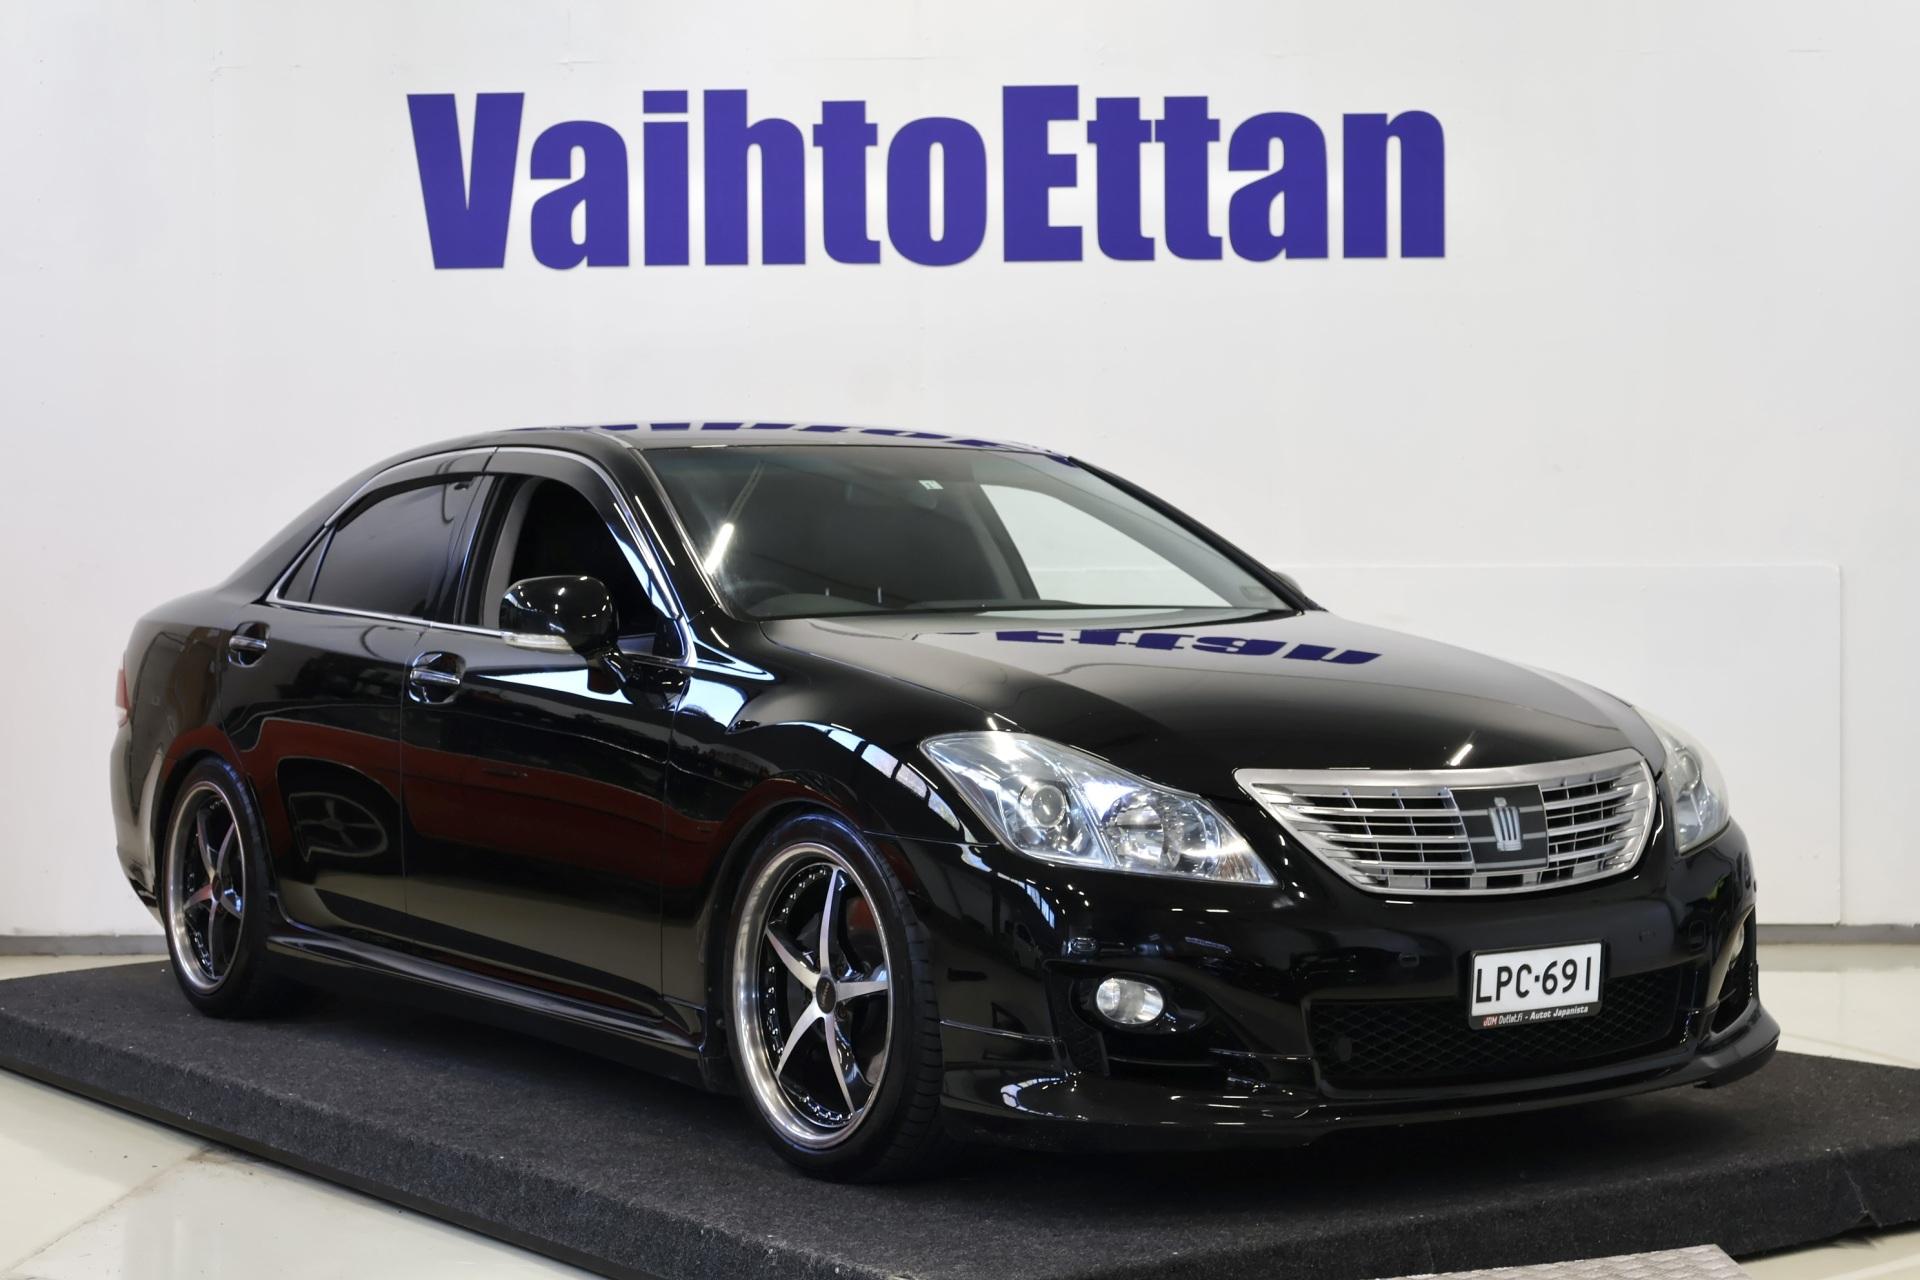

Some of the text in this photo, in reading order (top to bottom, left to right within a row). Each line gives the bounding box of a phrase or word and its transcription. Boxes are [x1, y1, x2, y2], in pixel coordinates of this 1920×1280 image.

[407, 85, 1446, 269] VaihtoEttan
[1530, 1010, 1552, 1020] Autot
[1552, 1005, 1589, 1018] Japanista
